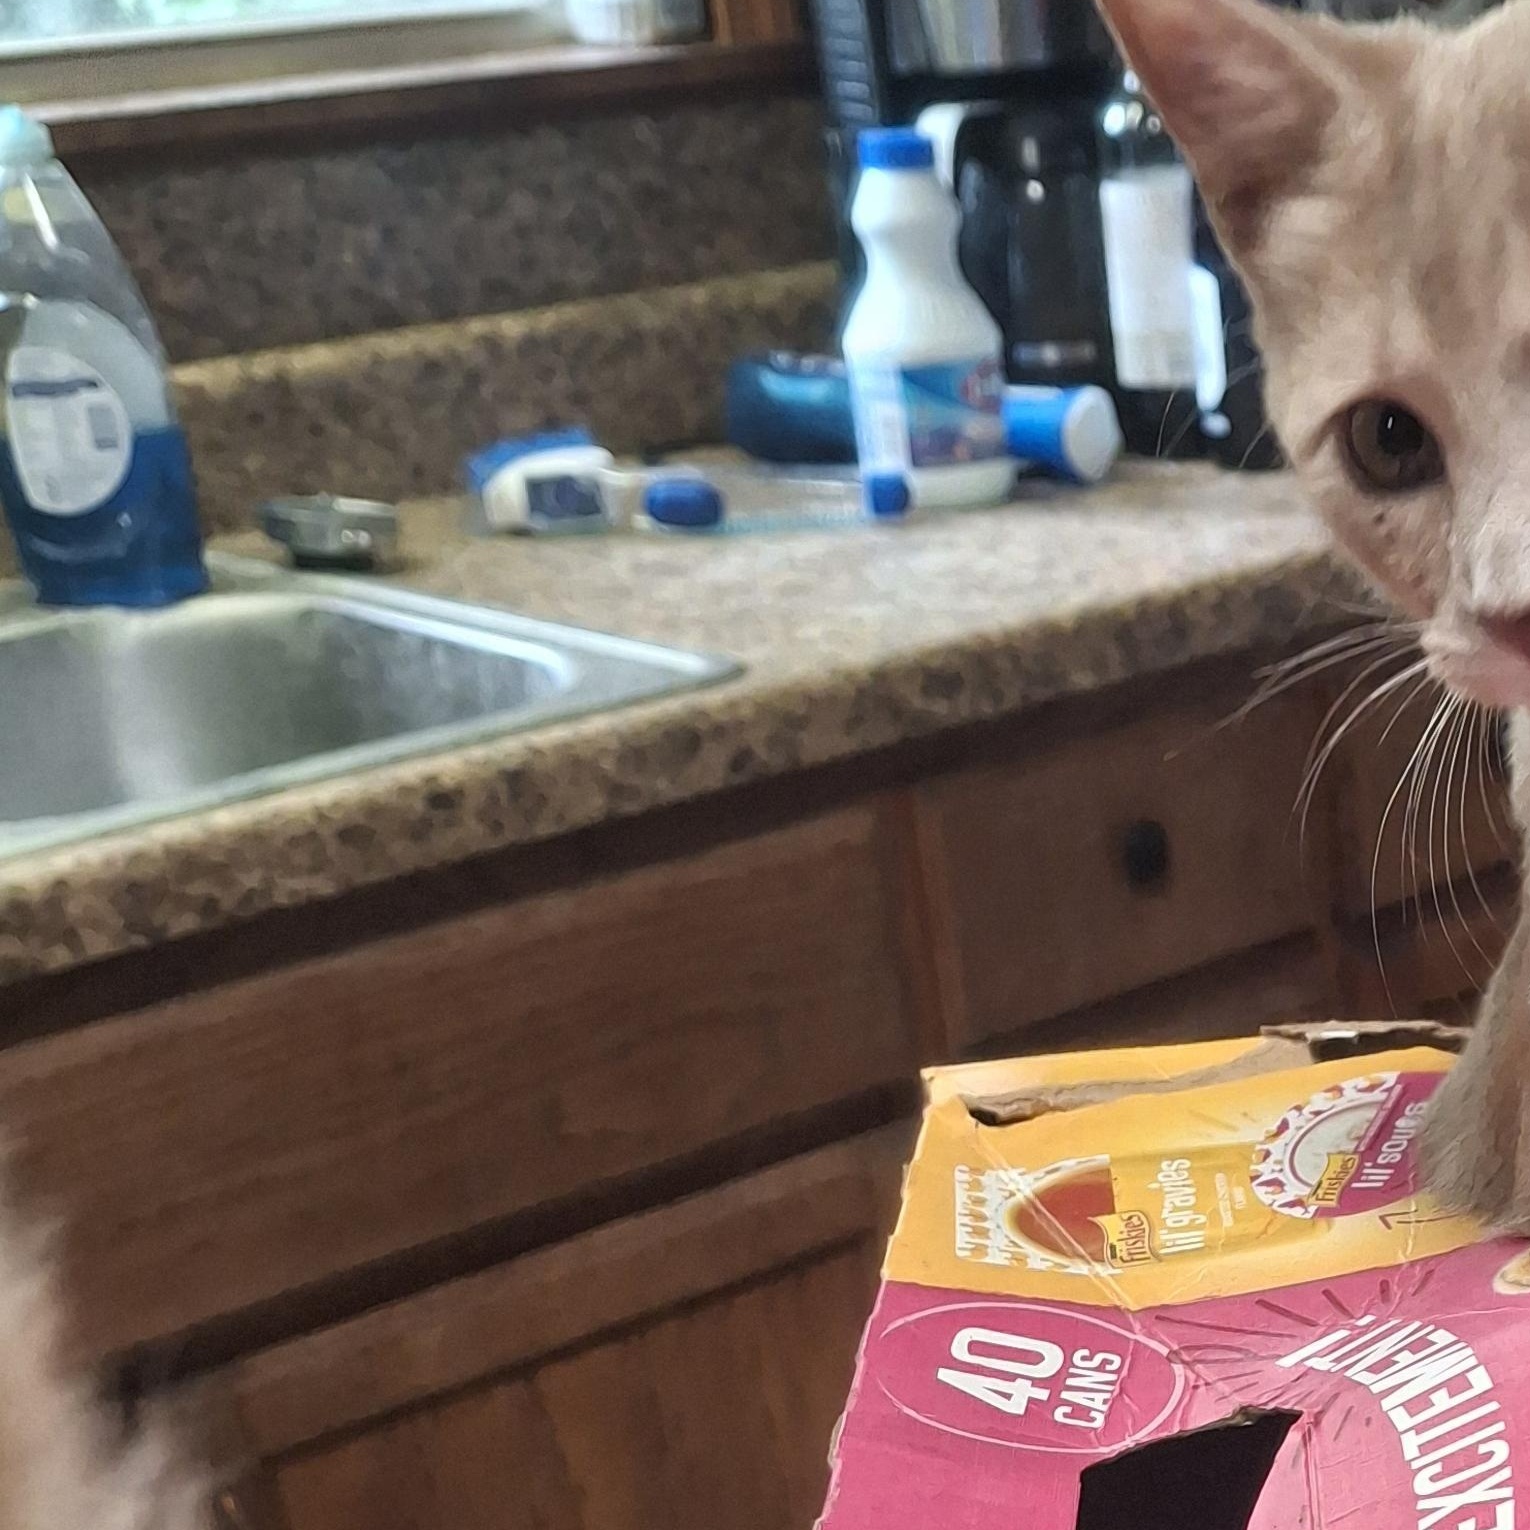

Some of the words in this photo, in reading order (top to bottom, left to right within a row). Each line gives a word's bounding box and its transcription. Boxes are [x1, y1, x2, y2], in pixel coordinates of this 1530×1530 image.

[1147, 1157, 1207, 1228] gravies
[1313, 1153, 1357, 1203] Friskies
[1118, 1213, 1152, 1264] Friskies
[937, 1327, 1065, 1415] 40
[1053, 1348, 1122, 1429] CANS
